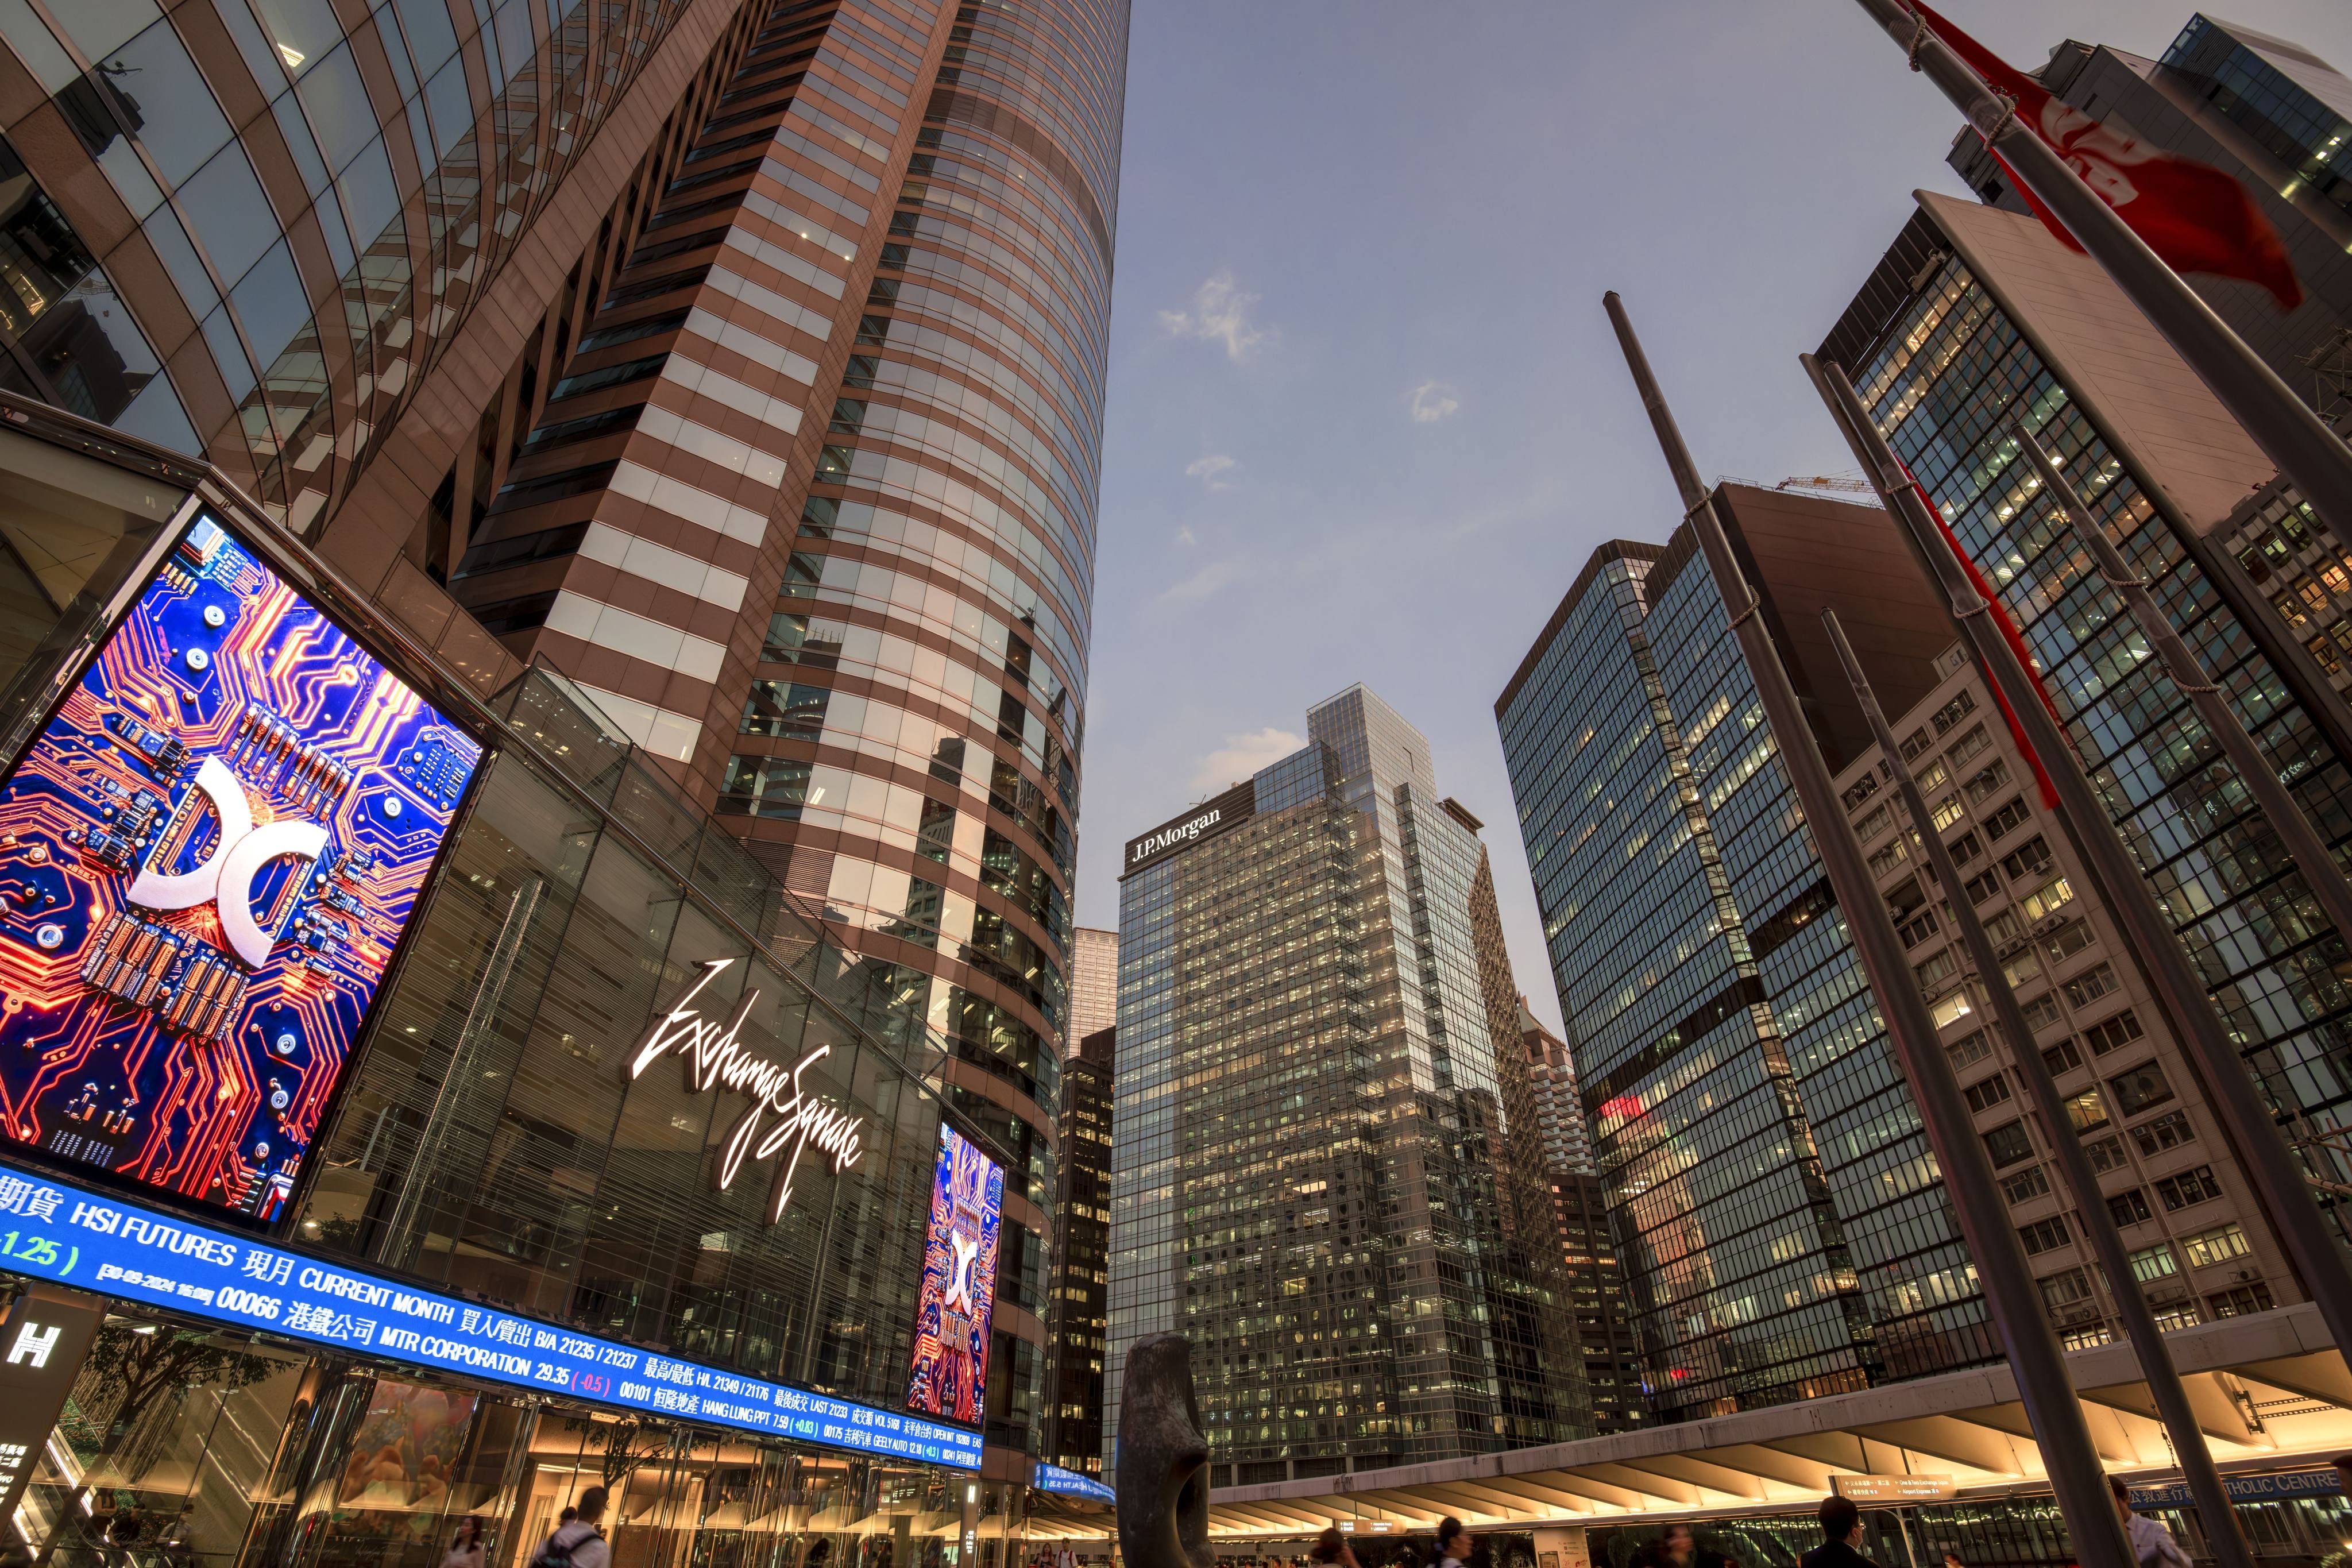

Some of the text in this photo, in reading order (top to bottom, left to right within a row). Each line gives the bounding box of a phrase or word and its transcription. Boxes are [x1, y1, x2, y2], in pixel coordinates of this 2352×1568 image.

[1132, 809, 1221, 862] J.P.Morgan
[633, 958, 863, 1224] Exchange Square
[0, 1175, 64, 1223] 期貨
[69, 1202, 123, 1234] HSI
[120, 1217, 237, 1266] FUTURES
[241, 1249, 295, 1285] 現月
[299, 1268, 393, 1307] CURRENT
[392, 1295, 454, 1324] MONTH
[534, 1330, 557, 1351] B/A
[559, 1337, 596, 1360] 21235
[603, 1349, 638, 1370] 21237
[696, 1372, 711, 1388] H/L
[713, 1376, 739, 1394] 21349
[744, 1383, 769, 1401] 21176
[774, 1389, 808, 1412] 最後成交
[810, 1399, 829, 1413] LAST
[829, 1403, 848, 1419] 21233
[875, 1414, 886, 1427] VOL
[887, 1417, 900, 1430] 5168
[933, 1429, 947, 1441] OPEN
[946, 1431, 955, 1442] INT
[972, 1437, 982, 1448] EAS
[0, 1230, 62, 1265] 1.25
[216, 1286, 283, 1319] 00066
[281, 1300, 377, 1346] 港鐵公司
[379, 1326, 421, 1352] MTR
[420, 1335, 532, 1377] CORPORATION
[534, 1362, 571, 1385] 29.35
[619, 1381, 651, 1402] 00101
[652, 1387, 700, 1415] 恒隆地產
[701, 1399, 729, 1418] HANG
[729, 1406, 754, 1423] LUNG
[753, 1410, 771, 1426] PPT
[773, 1415, 789, 1430] 7.59
[823, 1424, 843, 1440] 00175
[873, 1434, 892, 1449] GEELY
[891, 1438, 907, 1453] AUTO
[909, 1442, 922, 1455] 12.18
[2224, 1478, 2273, 1495] THOLIC
